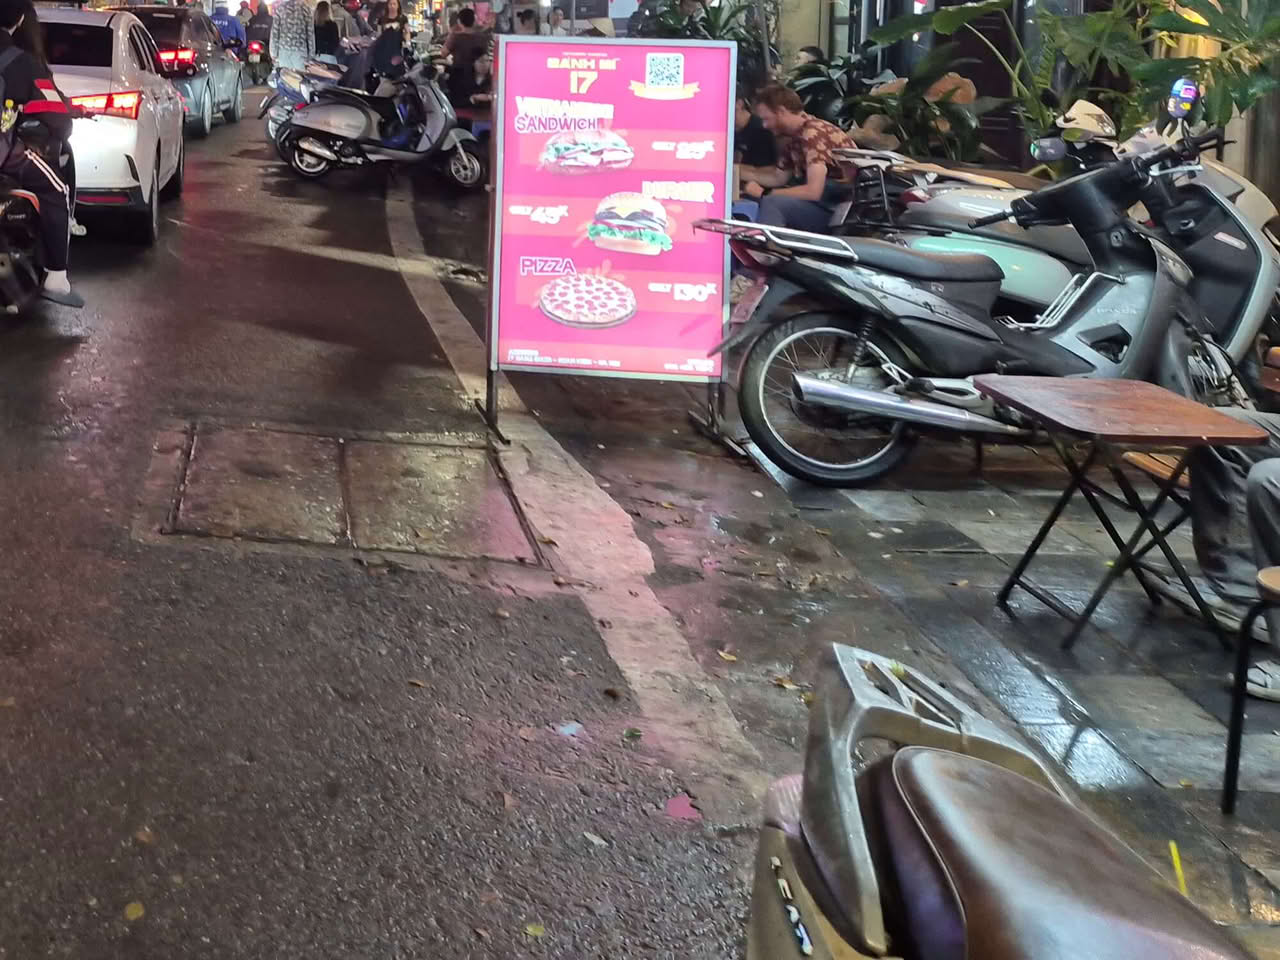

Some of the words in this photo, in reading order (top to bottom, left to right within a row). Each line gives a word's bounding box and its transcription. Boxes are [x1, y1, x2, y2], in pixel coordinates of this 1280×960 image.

[569, 70, 598, 94] 17
[515, 115, 601, 134] SANDWICH
[520, 257, 576, 276] PIZZA
